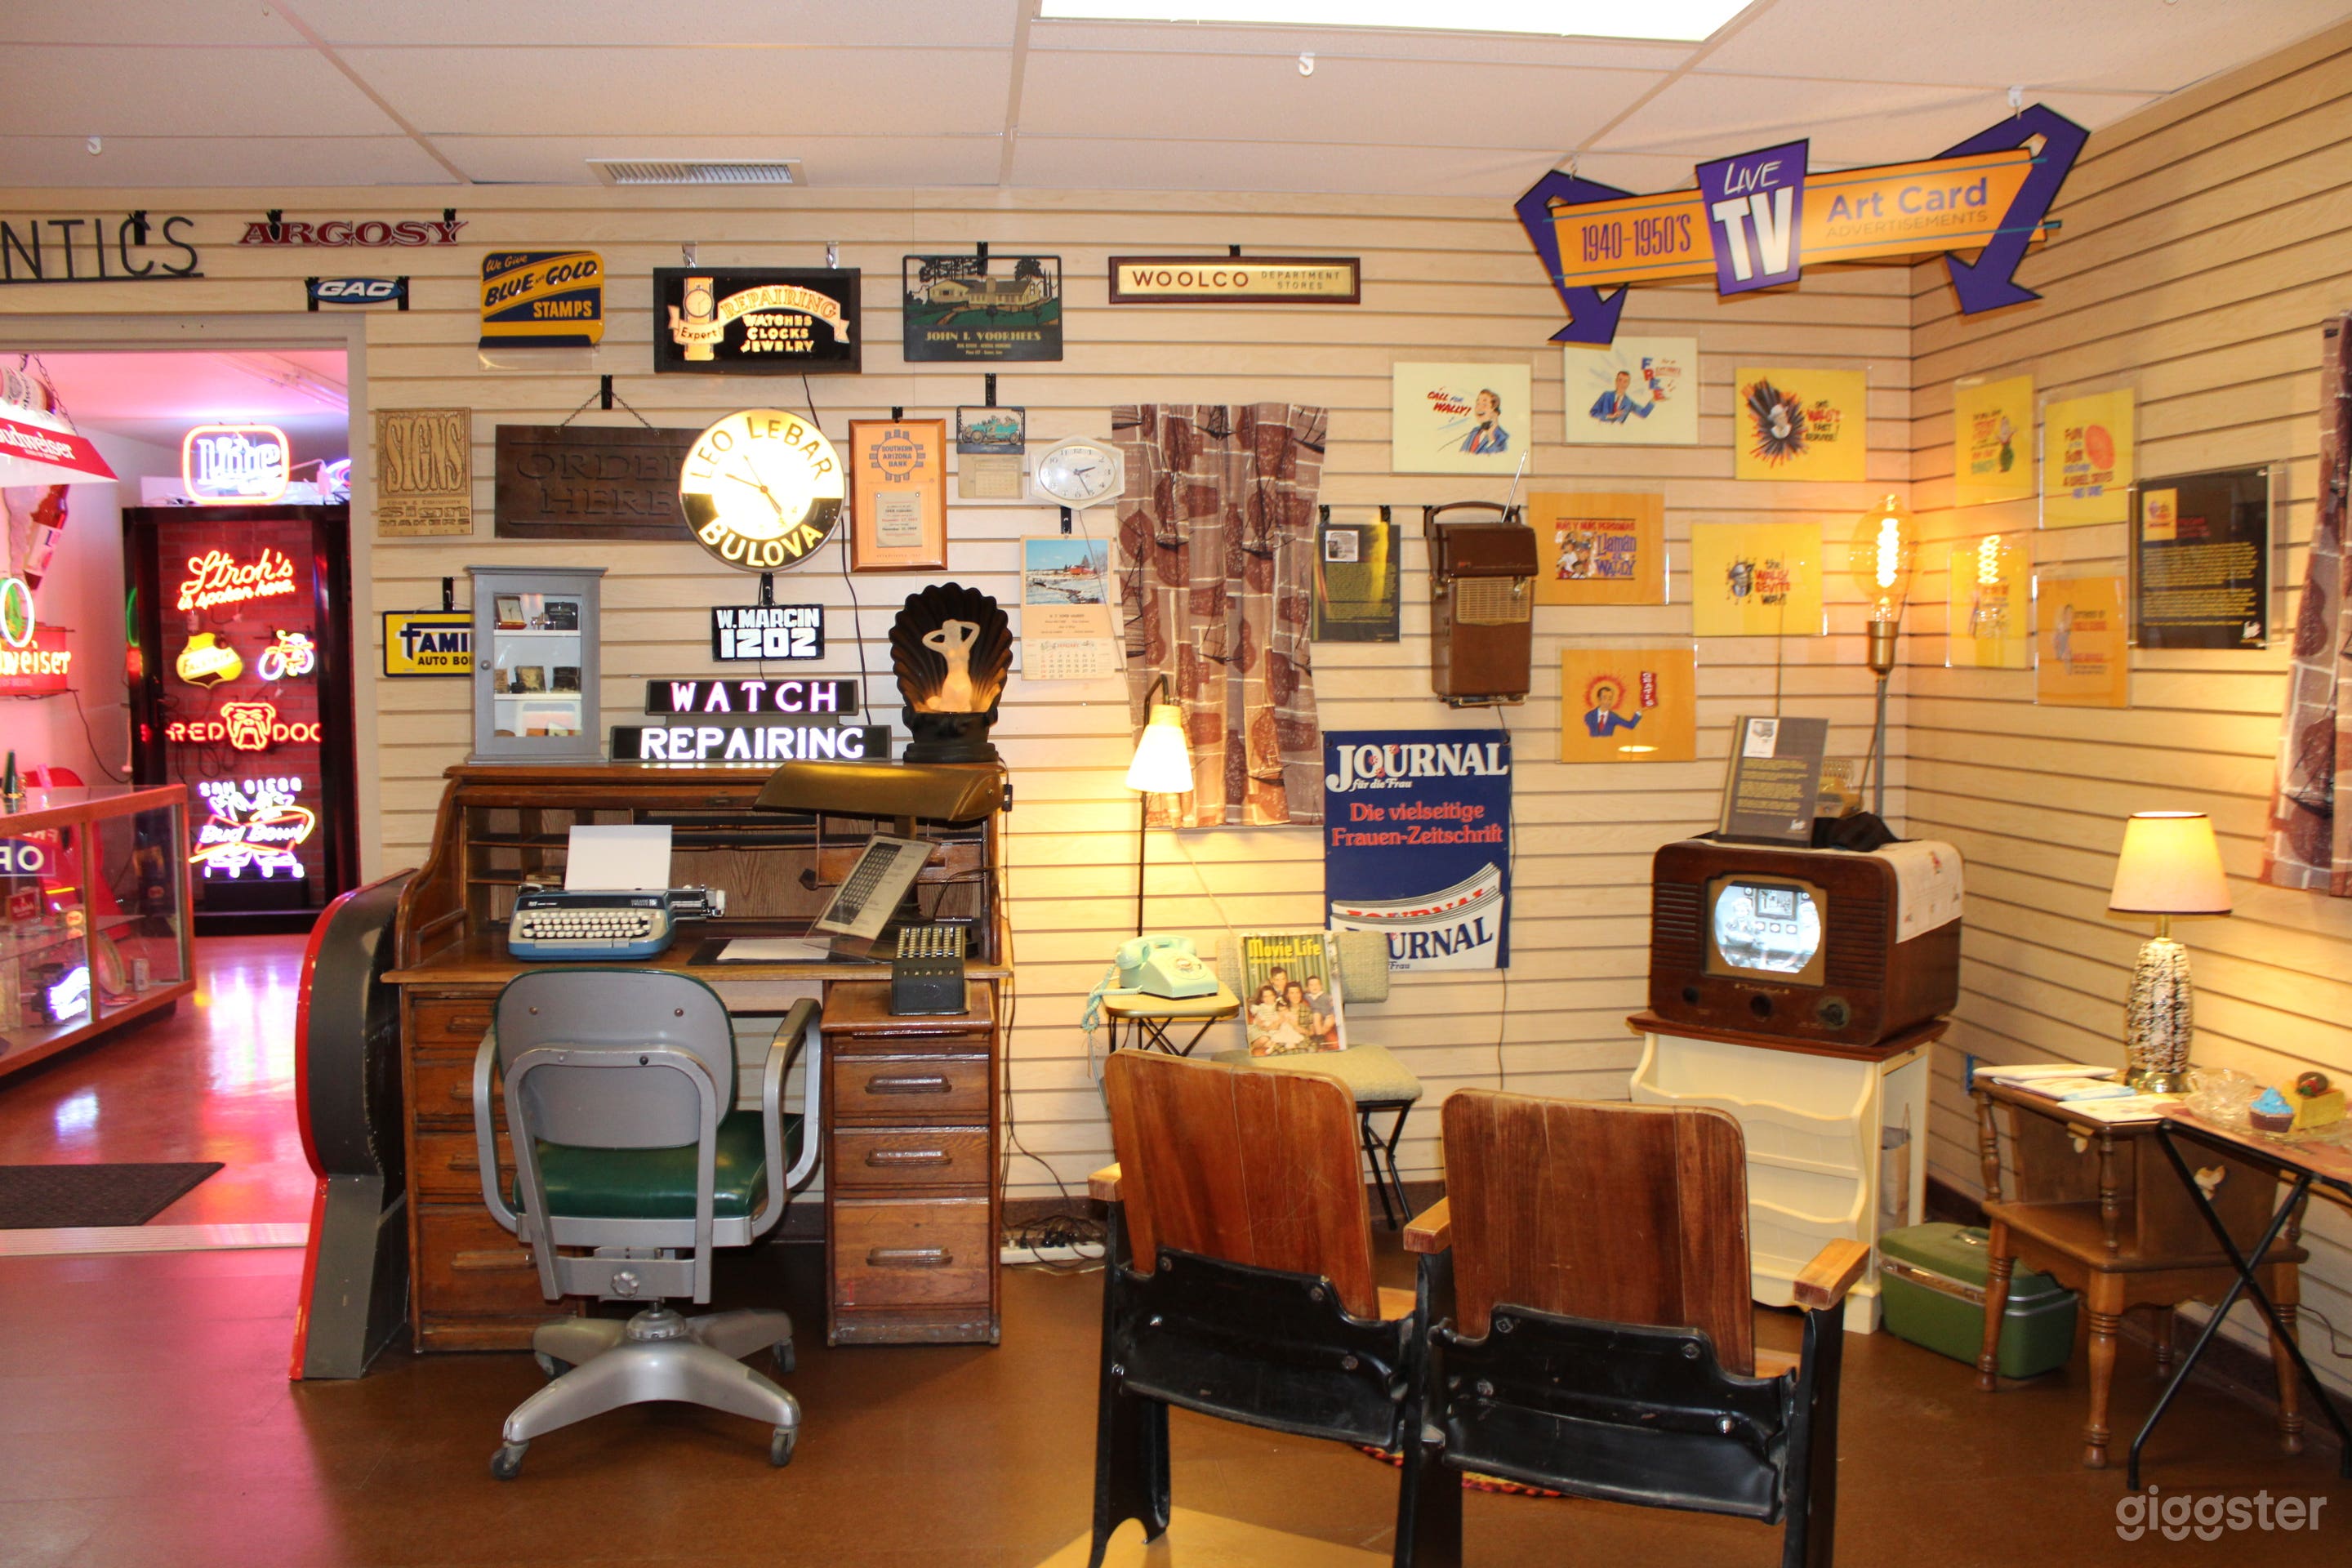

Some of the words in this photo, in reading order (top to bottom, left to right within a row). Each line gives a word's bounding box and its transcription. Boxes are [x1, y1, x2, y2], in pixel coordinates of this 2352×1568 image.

[1724, 160, 1782, 198] LIVE
[1826, 191, 1883, 225] Art
[1897, 177, 1989, 214] Card
[239, 220, 469, 246] ARGOSY
[1712, 185, 1794, 283] TV
[1826, 210, 1989, 239] ADVERTISEMENTS
[1580, 214, 1692, 263] 1940-1950'S
[486, 260, 501, 272] We
[504, 255, 528, 268] Give
[318, 280, 395, 298] GAC
[484, 273, 535, 307] BLUE
[545, 261, 597, 286] GOLD
[1132, 271, 1249, 287] WOOLCO
[1261, 271, 1340, 280] DEPARTMENT
[1277, 281, 1323, 289] STORES
[532, 301, 592, 318] STAMPS
[720, 288, 837, 319] REPAIRING
[742, 314, 813, 327] WATCHES
[680, 327, 717, 341] Expert
[740, 340, 814, 353] JEWELRY
[746, 327, 808, 341] CLOCKS
[925, 331, 958, 341] JOHN
[977, 330, 1041, 341] VOORHEES
[1427, 391, 1449, 401] CALL
[385, 416, 464, 492] SIGNS
[690, 430, 733, 479] LEO
[746, 416, 833, 482] LEBAR
[540, 488, 672, 516] HERE
[698, 516, 824, 567] BULOVA
[180, 548, 293, 595] Stroh's
[194, 585, 254, 610] spoken
[719, 628, 817, 658] 1202
[417, 657, 448, 666] AUTO
[453, 657, 470, 665] BO
[670, 682, 837, 712] WATCH
[166, 723, 225, 742] RED
[640, 728, 865, 760] REPAIRING
[1325, 742, 1509, 792] JOURNAL
[1350, 778, 1369, 791] für
[1370, 779, 1385, 789] die
[1386, 778, 1413, 789] Frau
[1350, 803, 1385, 822] Die
[1388, 800, 1485, 822] vielseitige
[198, 824, 246, 844] Bud
[1332, 823, 1503, 847] Frauen-Zeitschrift
[1247, 938, 1293, 957] Movie
[1294, 938, 1321, 956] Life
[1346, 917, 1493, 960] URNAL
